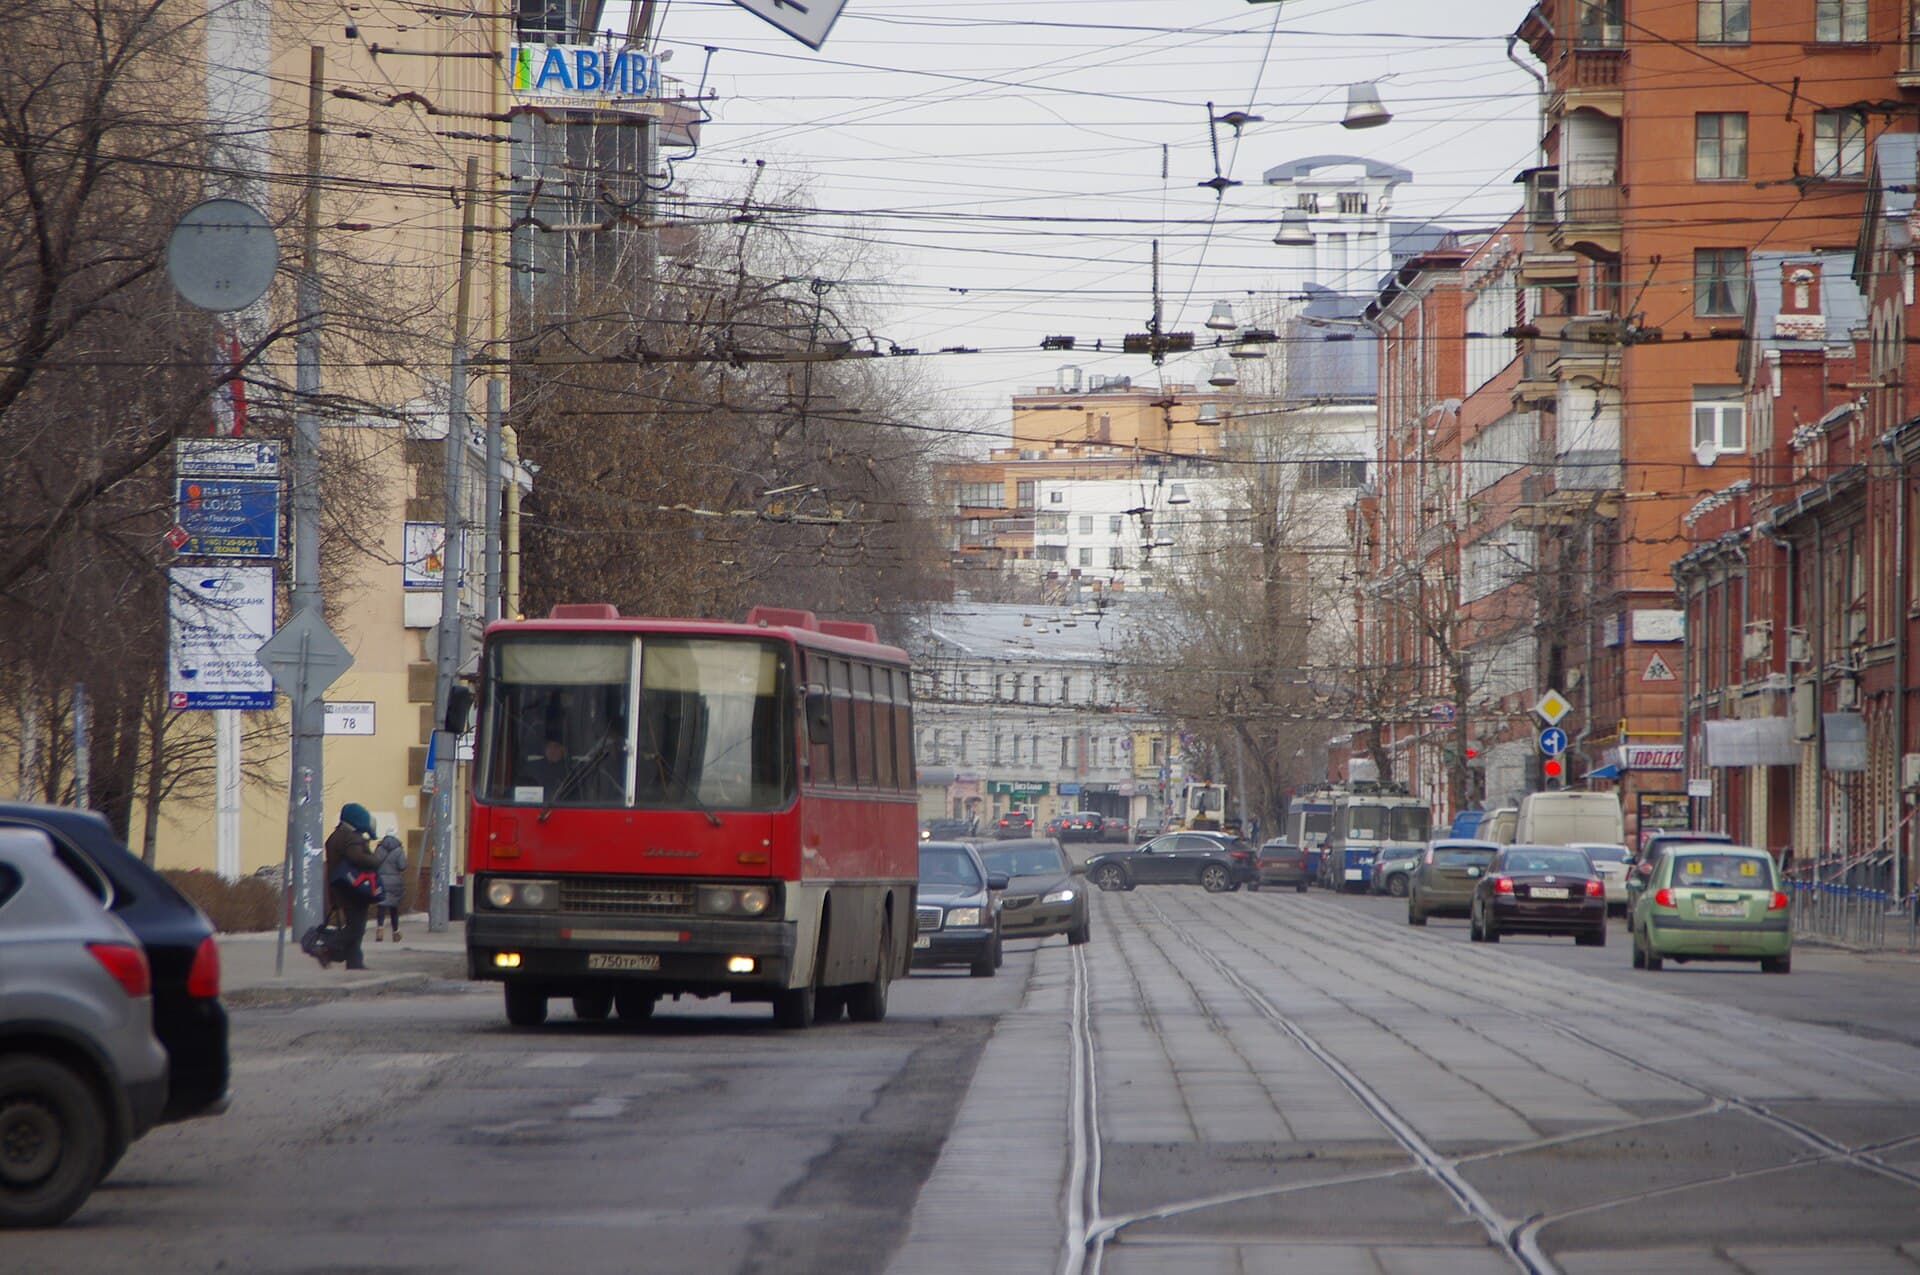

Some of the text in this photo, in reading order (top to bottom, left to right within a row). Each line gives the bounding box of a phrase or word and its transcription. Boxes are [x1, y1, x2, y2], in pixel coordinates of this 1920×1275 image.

[535, 48, 660, 98] АВИВА
[342, 718, 356, 729] 78
[1634, 751, 1684, 767] ПРОДУ
